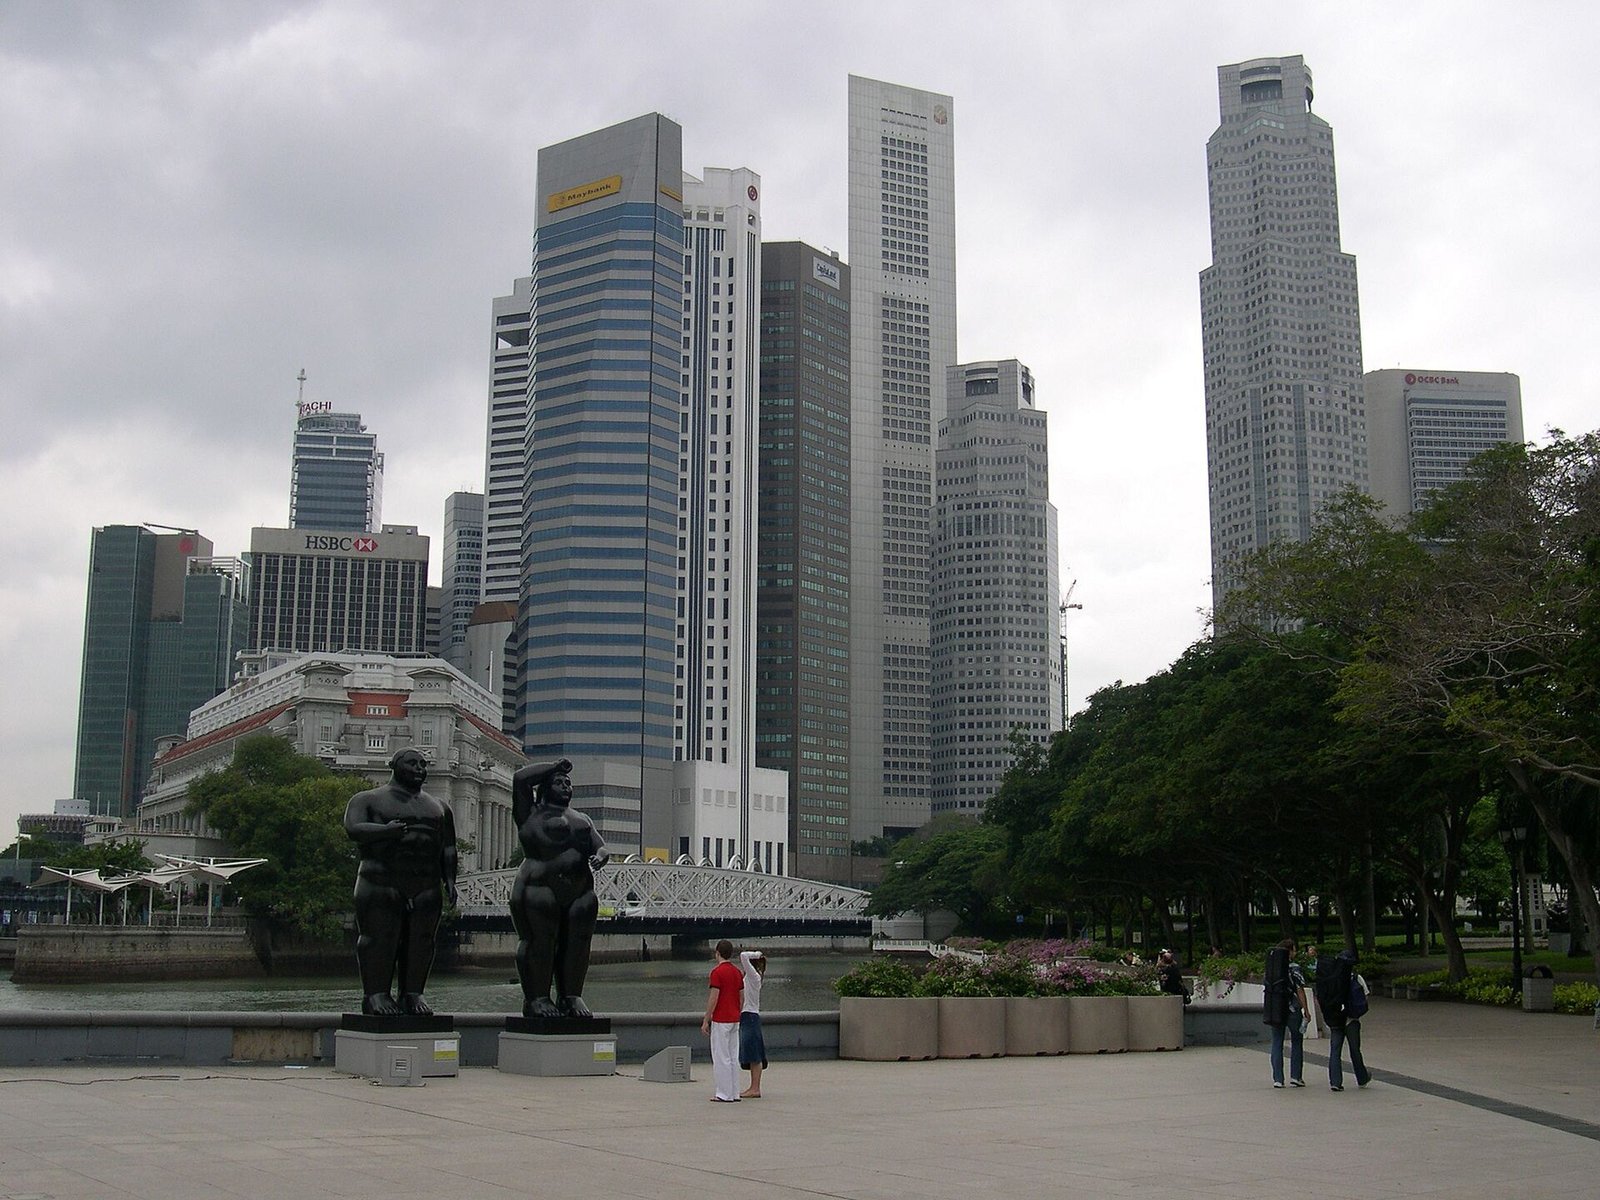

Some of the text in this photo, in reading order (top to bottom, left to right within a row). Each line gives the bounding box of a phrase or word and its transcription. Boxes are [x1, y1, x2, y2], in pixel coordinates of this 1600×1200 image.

[567, 184, 612, 201] Maybank
[1417, 375, 1460, 385] OCBC Bank
[304, 535, 352, 551] HSBC
